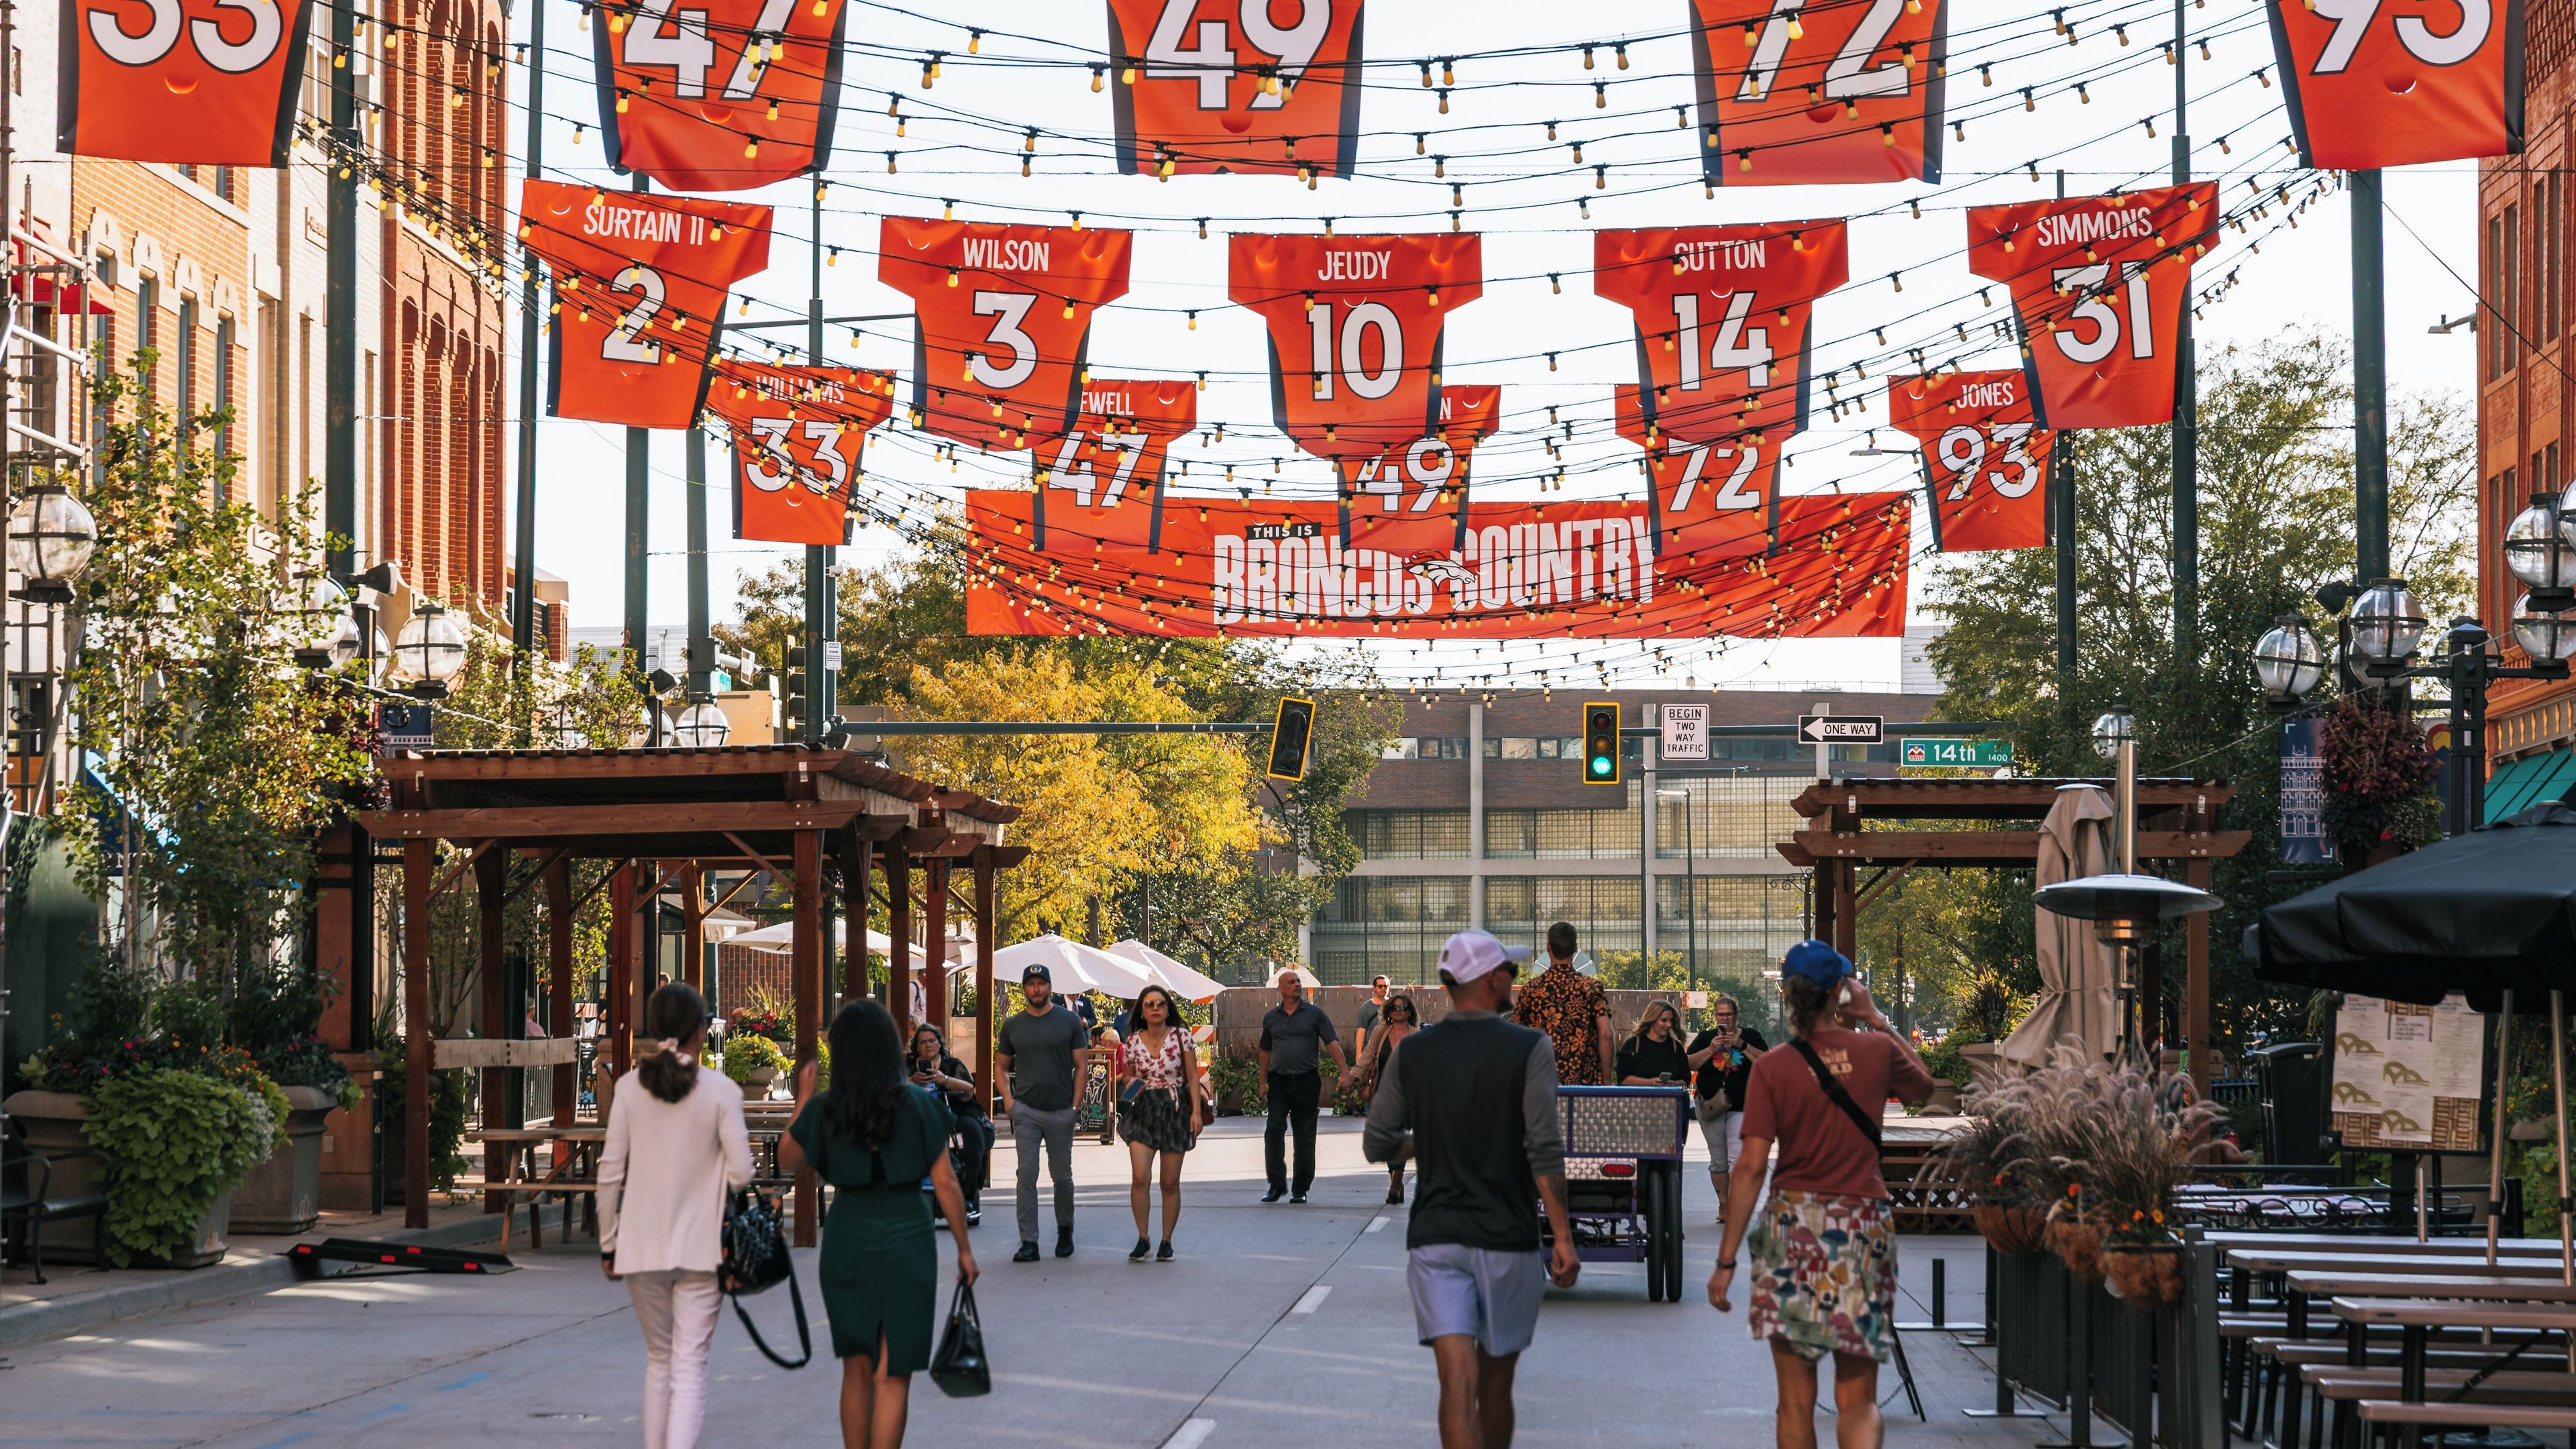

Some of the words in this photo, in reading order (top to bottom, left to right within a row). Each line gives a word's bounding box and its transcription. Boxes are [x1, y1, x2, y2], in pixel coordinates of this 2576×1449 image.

[1144, 0, 1333, 111] 49
[584, 205, 681, 245] SURTAIN
[2037, 207, 2153, 247] SIMMONS
[963, 237, 1049, 271] WILSON
[1318, 251, 1391, 281] JEUDY
[1674, 240, 1766, 271] SUTTON
[600, 265, 666, 366] 2
[2051, 260, 2155, 364] 31
[965, 289, 1039, 389] 3
[1307, 302, 1404, 401] 10
[1672, 290, 1774, 391] 14
[756, 376, 845, 404] WILLIAMS
[1956, 382, 2014, 409] JONES
[745, 416, 847, 495] 33
[1048, 431, 1151, 508] 47
[1938, 421, 2039, 501] 93
[1355, 437, 1454, 512] 49
[1667, 437, 1760, 512] 72
[1254, 527, 1290, 538] THIS
[1298, 525, 1312, 537] IS
[1669, 709, 1701, 718] BEGIN
[1676, 722, 1695, 731] TWO
[1825, 724, 1846, 735] ONE
[1850, 724, 1872, 735] WAY
[1667, 744, 1703, 752] TRAFFIC
[1676, 733, 1695, 742] WAY
[1934, 745, 1976, 762] 14th
[1988, 754, 2008, 762] 1400
